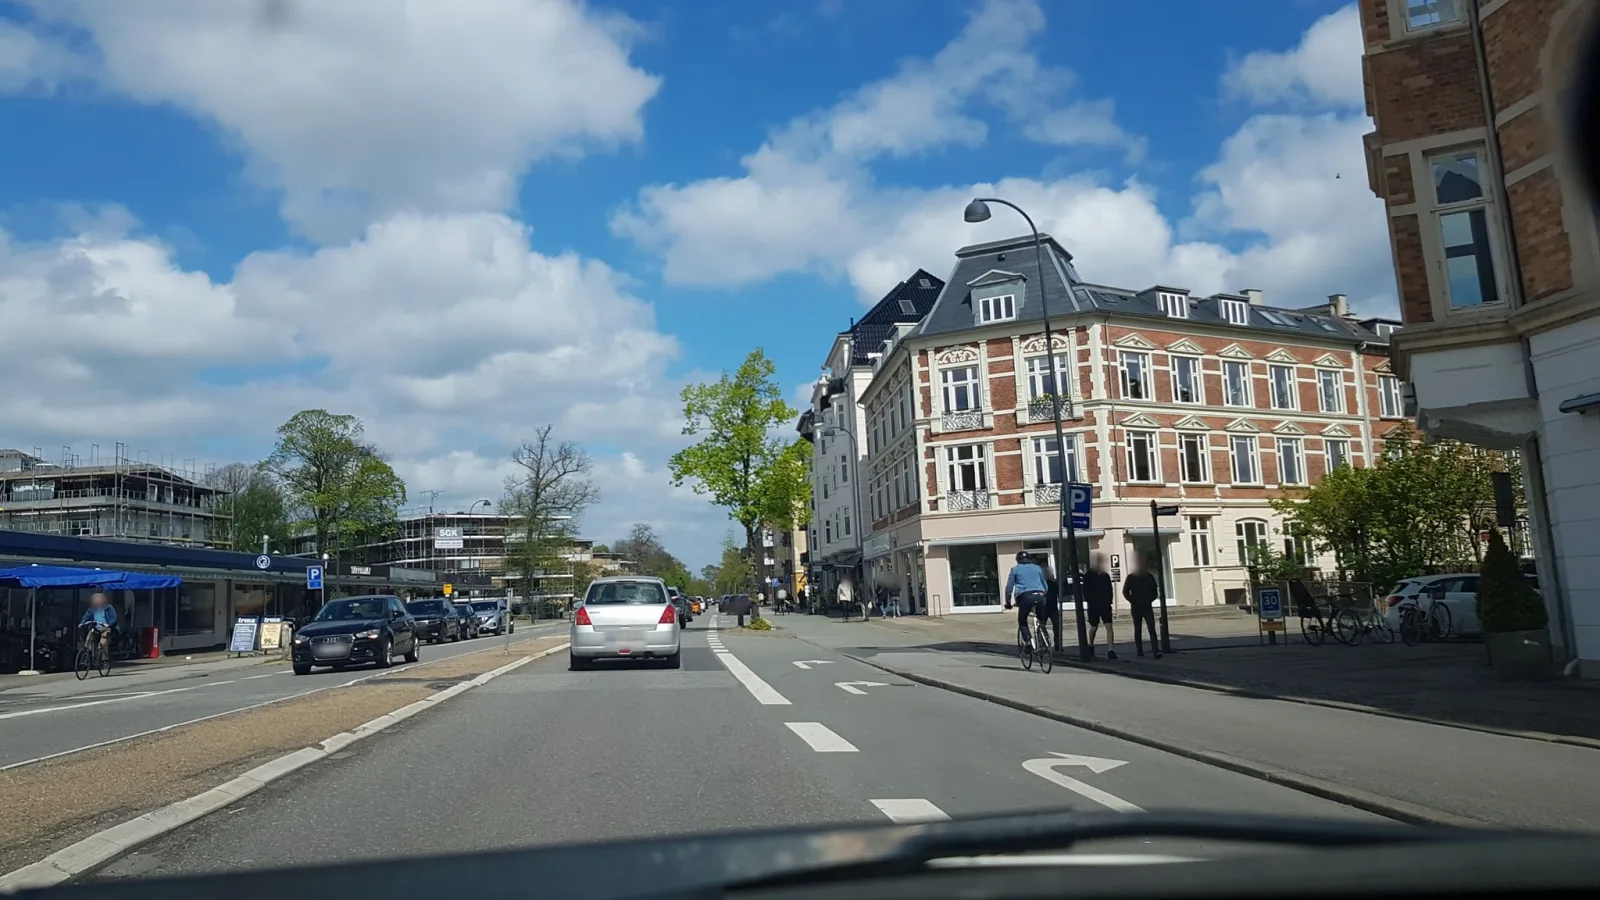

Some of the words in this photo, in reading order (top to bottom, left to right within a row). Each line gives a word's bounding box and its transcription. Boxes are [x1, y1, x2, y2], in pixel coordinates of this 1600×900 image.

[1070, 488, 1086, 510] P
[440, 529, 458, 537] SGK
[1112, 555, 1119, 567] P
[311, 568, 319, 580] P
[1263, 595, 1278, 606] 30
